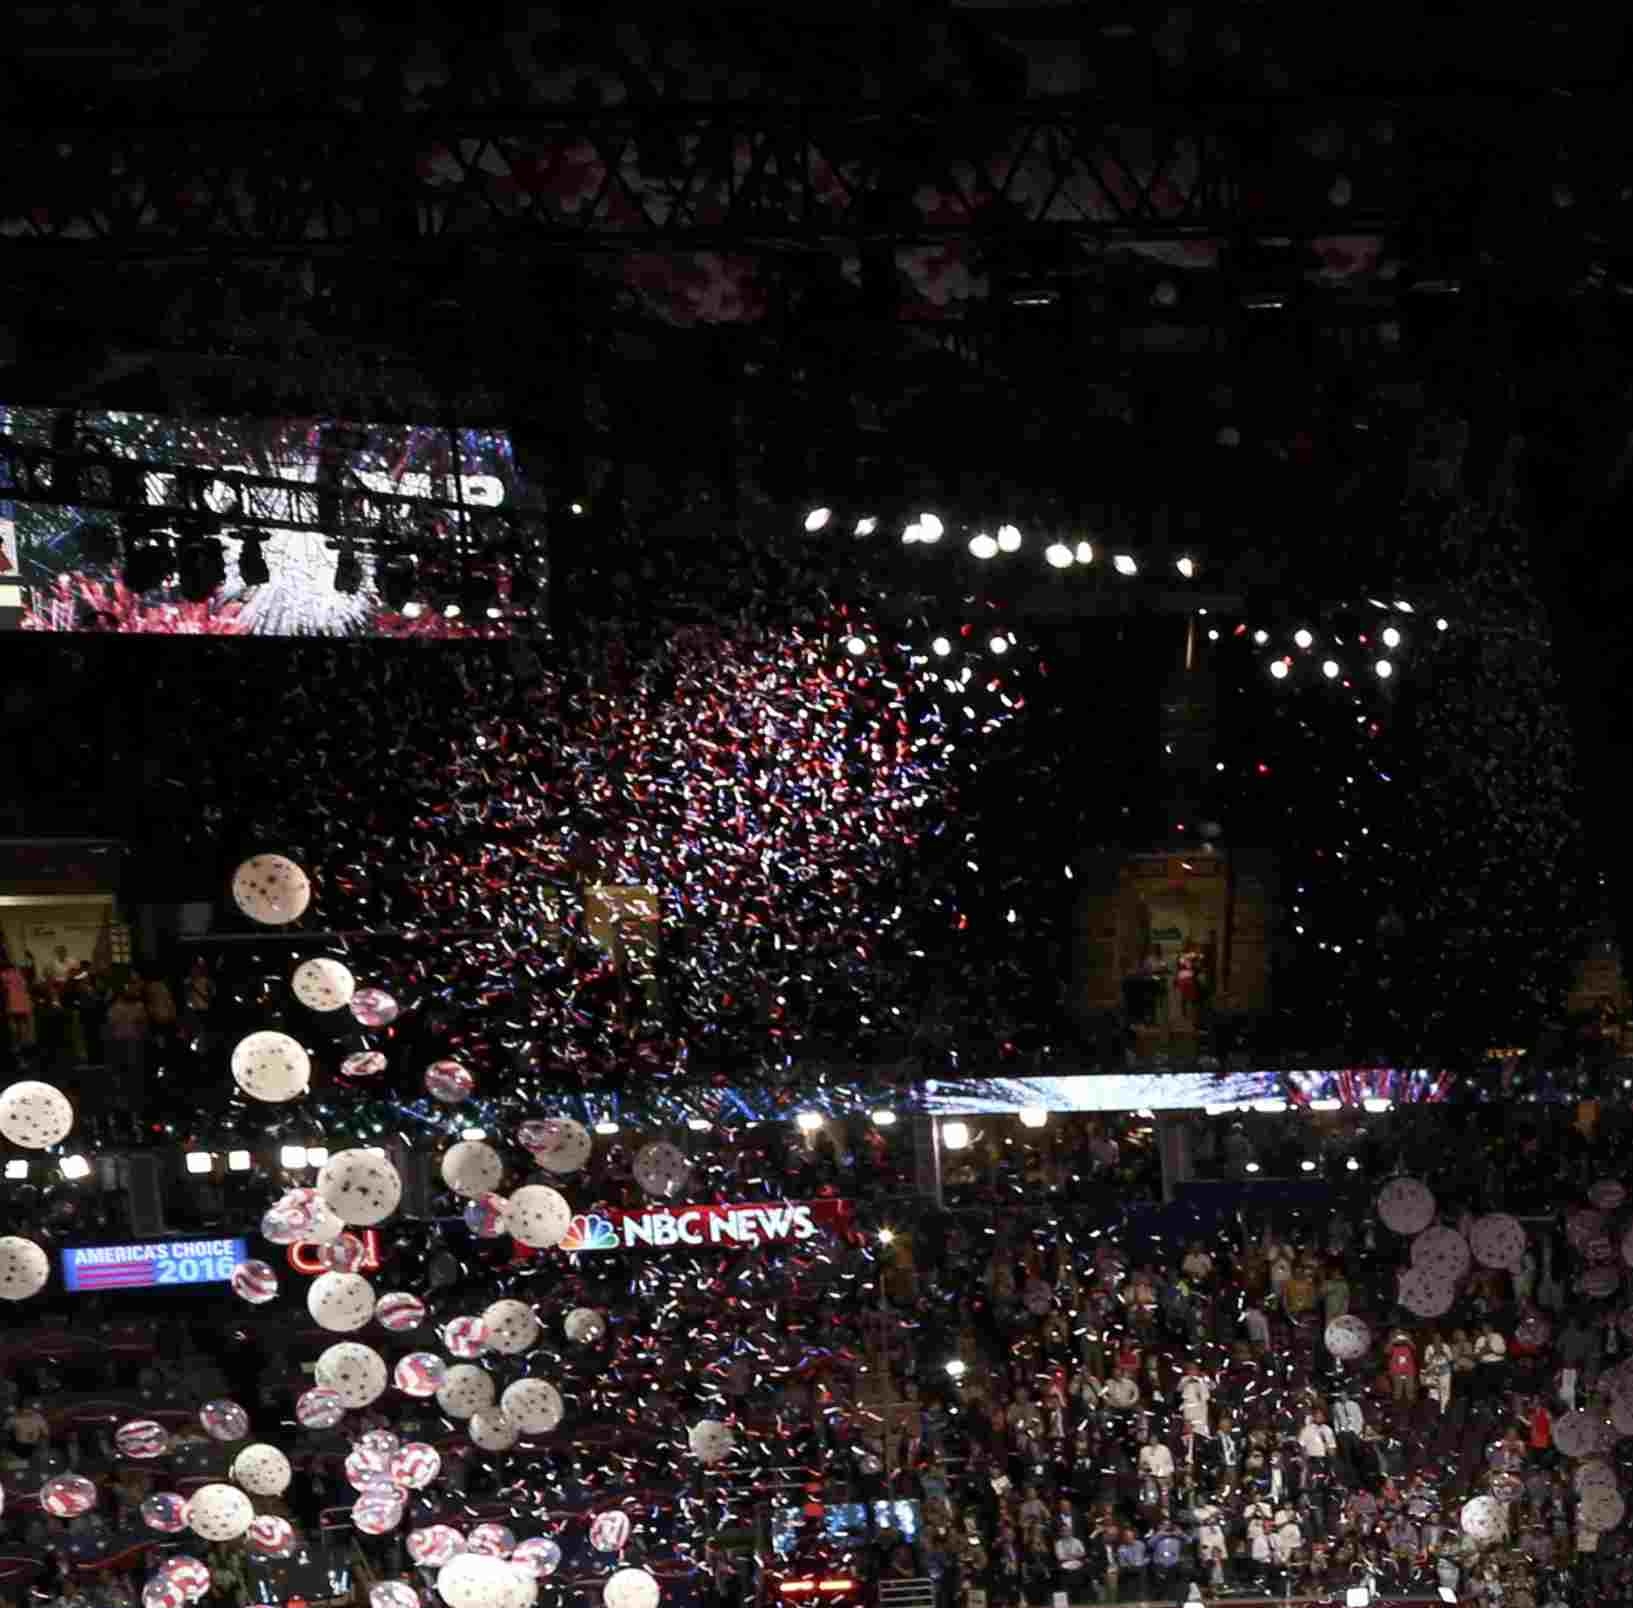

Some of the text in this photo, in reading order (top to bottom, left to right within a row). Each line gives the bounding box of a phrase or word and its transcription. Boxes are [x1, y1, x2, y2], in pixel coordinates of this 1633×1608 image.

[623, 1205, 813, 1246] NBC NEWS
[74, 1239, 234, 1264] AMERICA'S CHOICE
[156, 1256, 235, 1284] 2016
